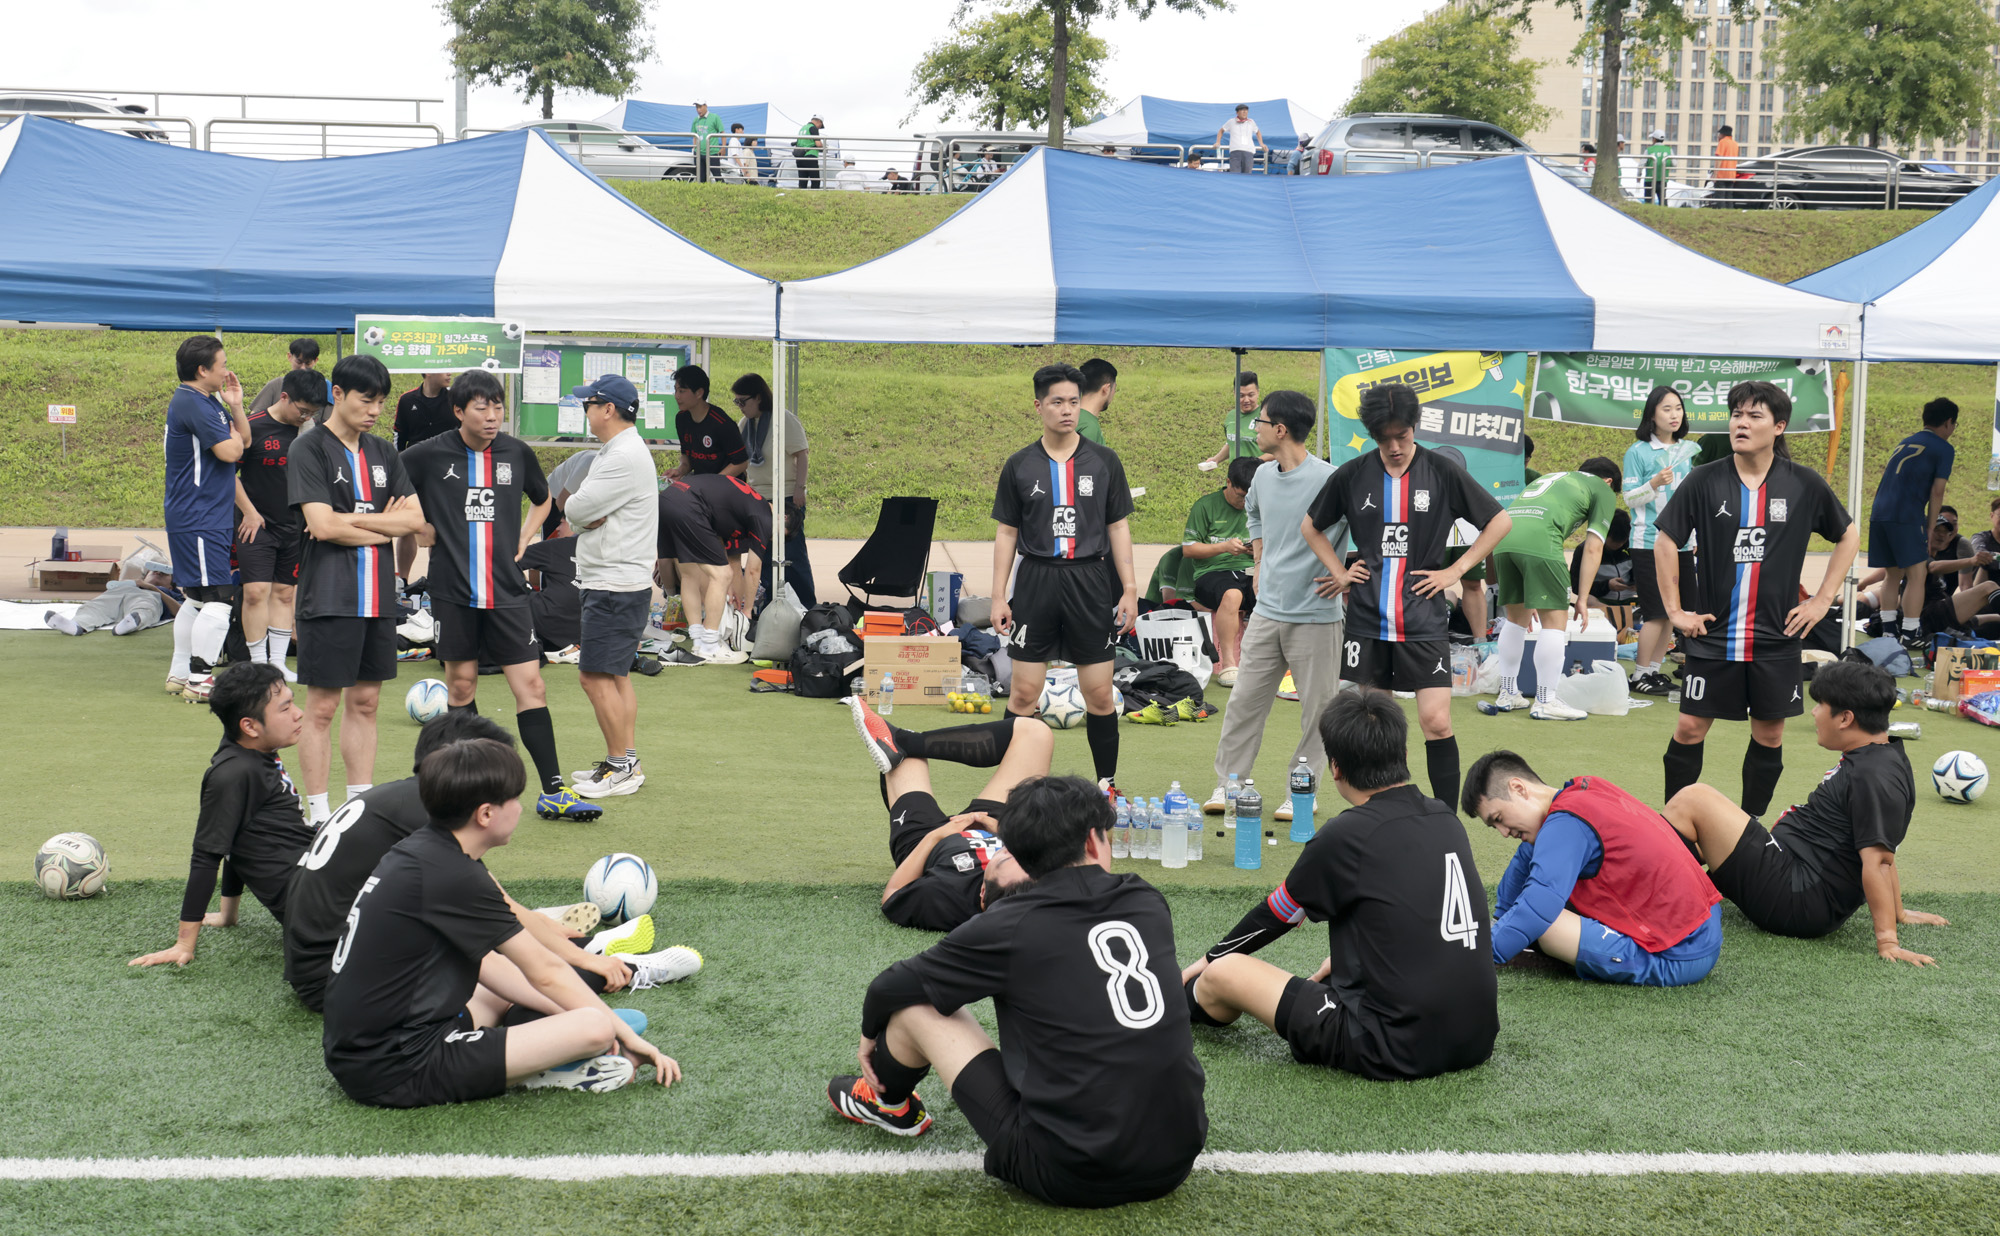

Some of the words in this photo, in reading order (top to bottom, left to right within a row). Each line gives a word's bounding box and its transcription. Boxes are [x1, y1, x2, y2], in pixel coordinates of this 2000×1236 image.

[390, 332, 442, 344] 우주최강!
[444, 333, 489, 344] 일간스포츠
[381, 344, 405, 357] 우승
[408, 345, 432, 356] 향해
[1356, 350, 1397, 371] 단독!
[1586, 353, 1634, 370] 한골일보
[1639, 356, 1650, 372] 기
[1654, 357, 1679, 373] 팍팍
[1681, 358, 1705, 374] 받고
[1565, 368, 1655, 402] 한국일보
[60, 407, 75, 416] 위험
[1419, 406, 1444, 434] 폼
[1449, 410, 1522, 444] 미쳤다
[264, 439, 281, 451] 88
[1886, 443, 1927, 475] 77
[466, 488, 495, 506] FC
[464, 505, 495, 521] 일요신문
[1052, 507, 1076, 523] FC
[1052, 522, 1076, 537] 일요신문
[1382, 525, 1409, 542] FC
[1734, 528, 1767, 546] FC
[1381, 541, 1408, 557] 일요신문
[1733, 545, 1765, 563] 일요신문
[1008, 620, 1028, 649] 24
[1344, 640, 1361, 668] 18
[1683, 674, 1707, 701] 10
[1440, 851, 1480, 951] 4
[331, 875, 381, 974] 5
[1087, 920, 1165, 1030] 8
